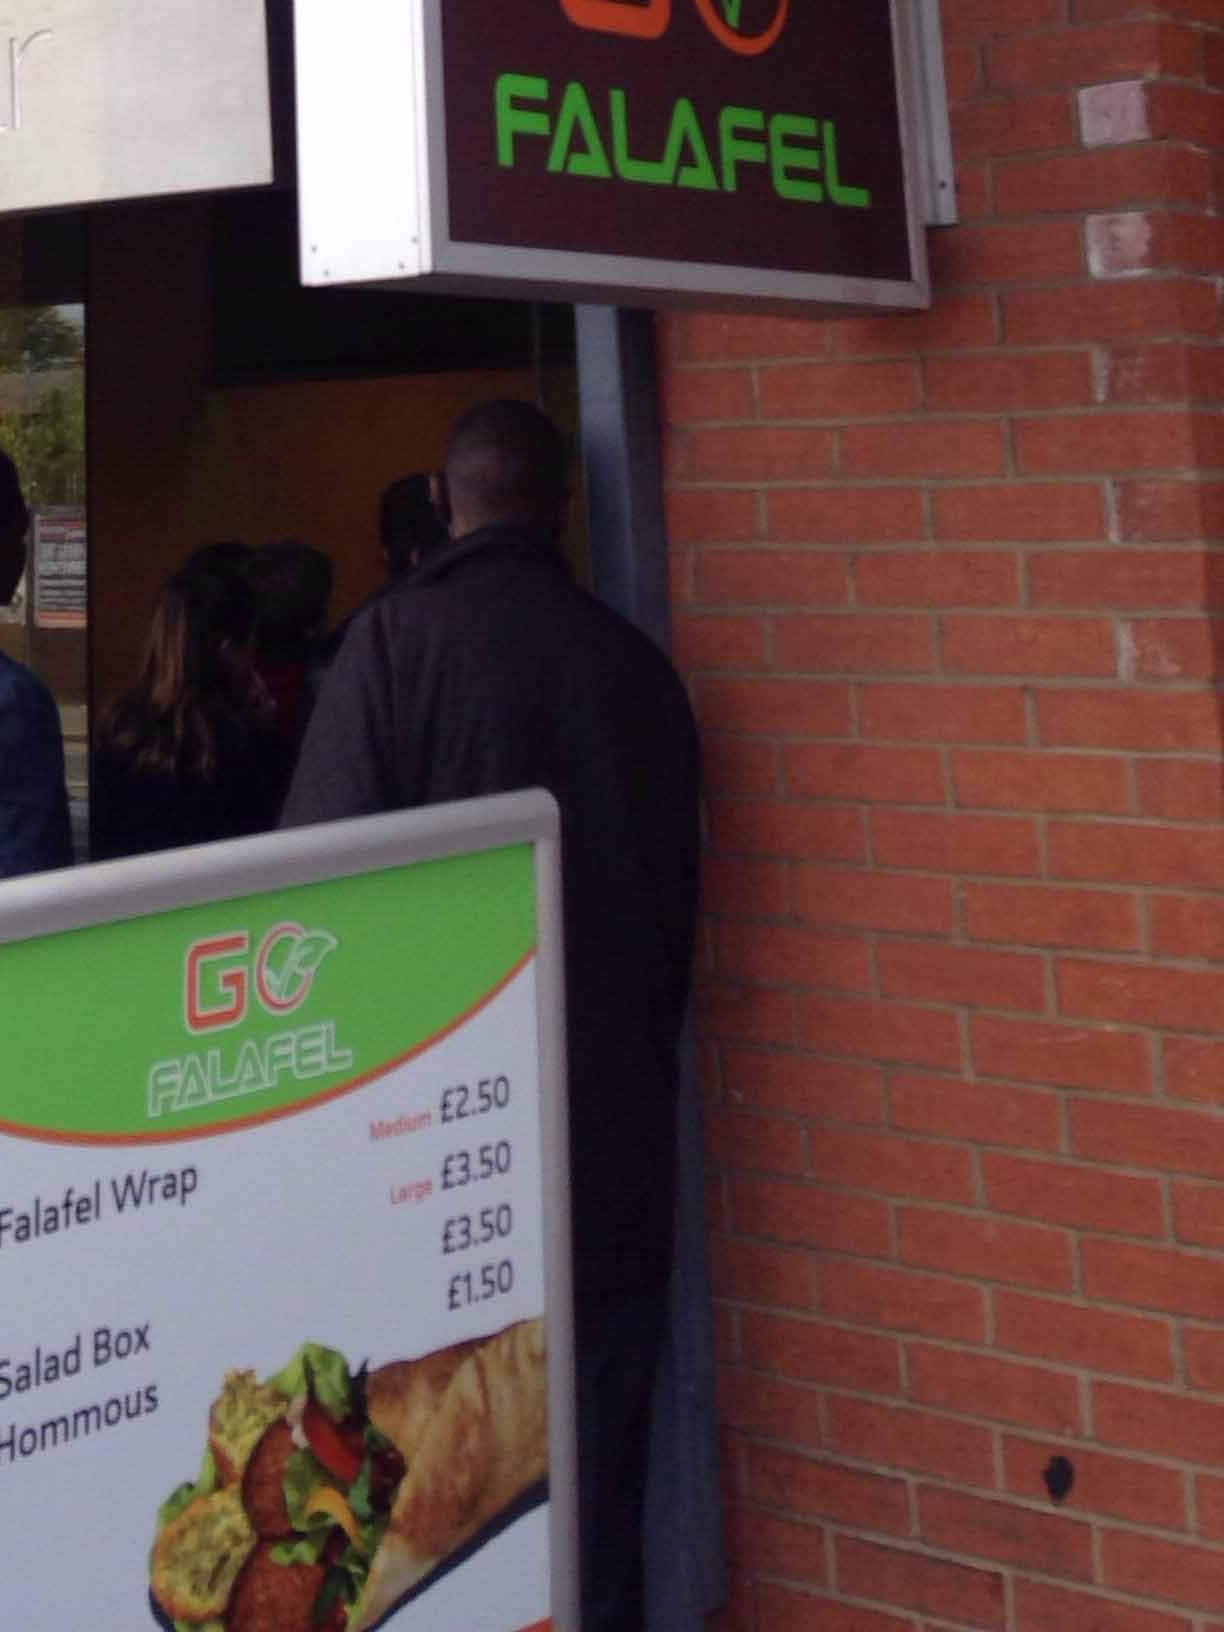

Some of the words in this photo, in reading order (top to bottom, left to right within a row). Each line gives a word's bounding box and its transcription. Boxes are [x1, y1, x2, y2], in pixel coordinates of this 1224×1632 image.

[495, 73, 871, 208] FALAFEL
[186, 921, 338, 1035] GO
[147, 1020, 354, 1117] FALAFEL
[440, 1075, 509, 1124] £2.50
[111, 1165, 198, 1215] Wrap
[390, 1179, 432, 1205] Large
[441, 1141, 511, 1190] £3.50
[442, 1203, 512, 1255] £3.50
[448, 1260, 513, 1310] £1.50
[92, 1323, 152, 1367] Box
